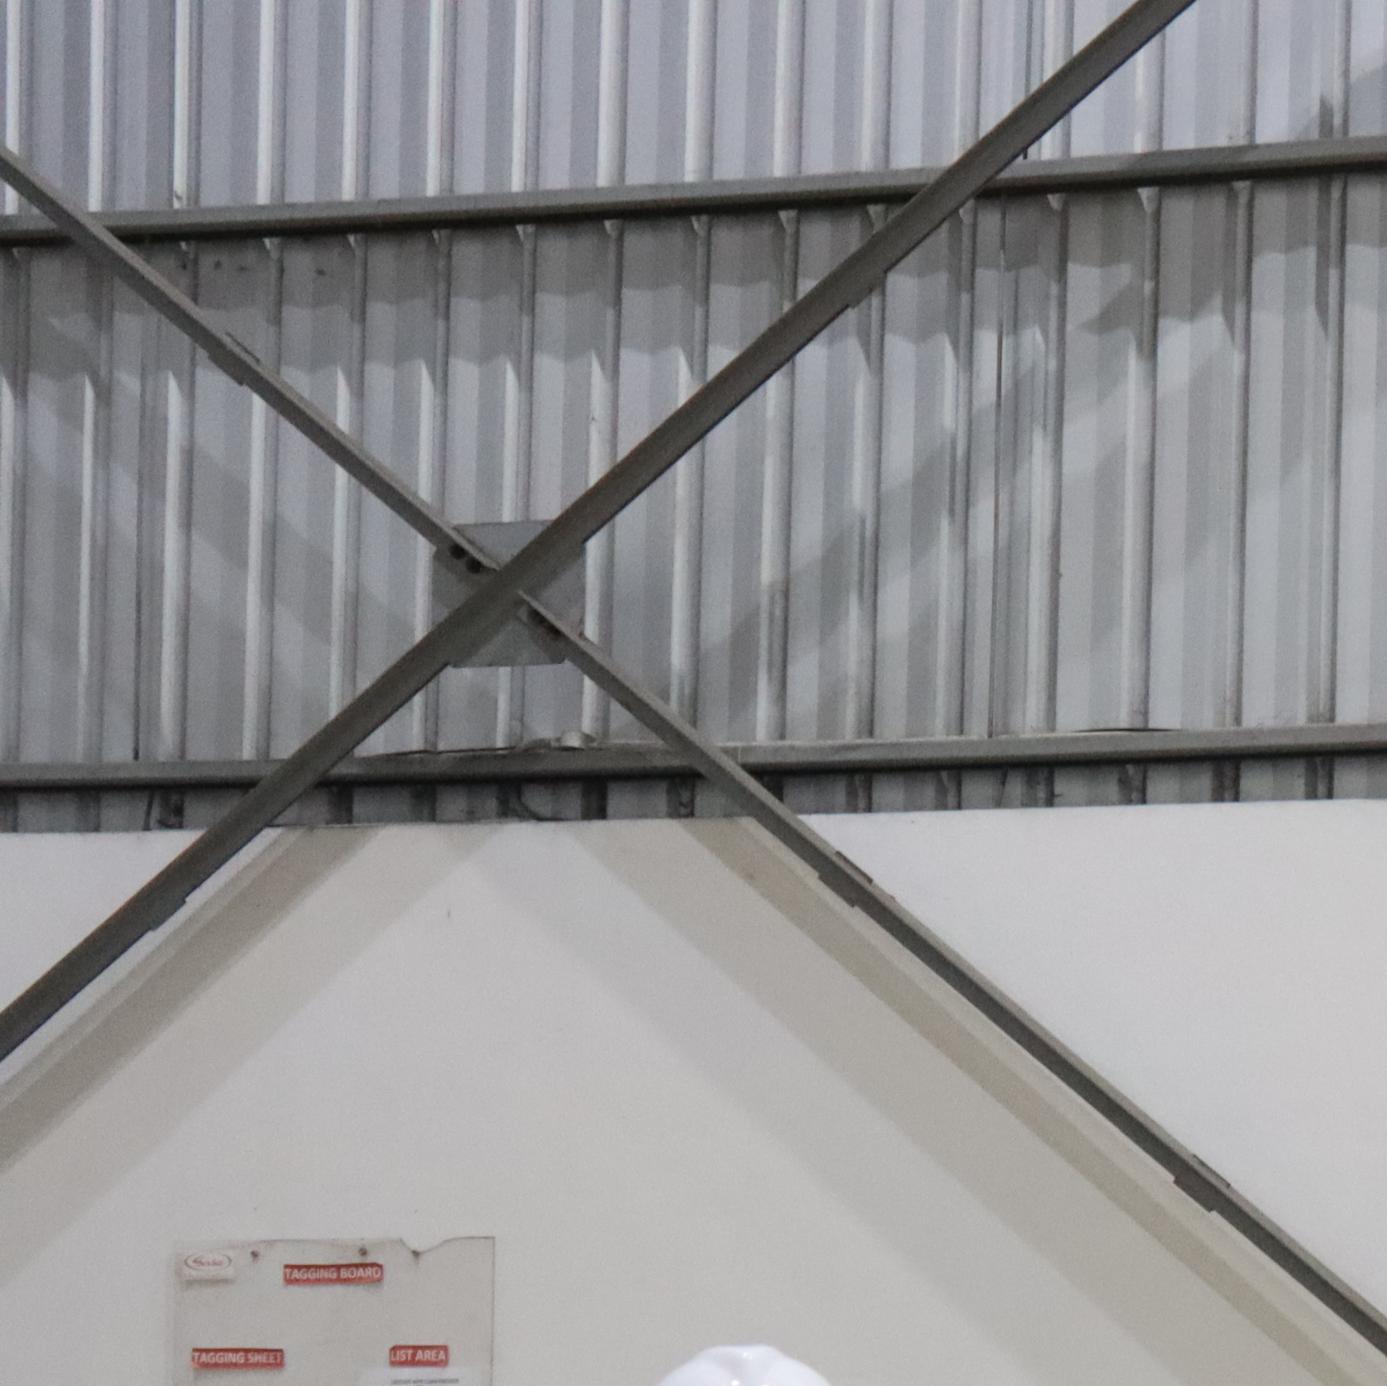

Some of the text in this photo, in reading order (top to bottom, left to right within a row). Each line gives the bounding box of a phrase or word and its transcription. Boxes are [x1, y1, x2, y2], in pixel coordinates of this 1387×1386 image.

[285, 1266, 381, 1280] TAGGING BOARD
[192, 1351, 245, 1364] TAGGING
[391, 1349, 446, 1362] LIST AREA
